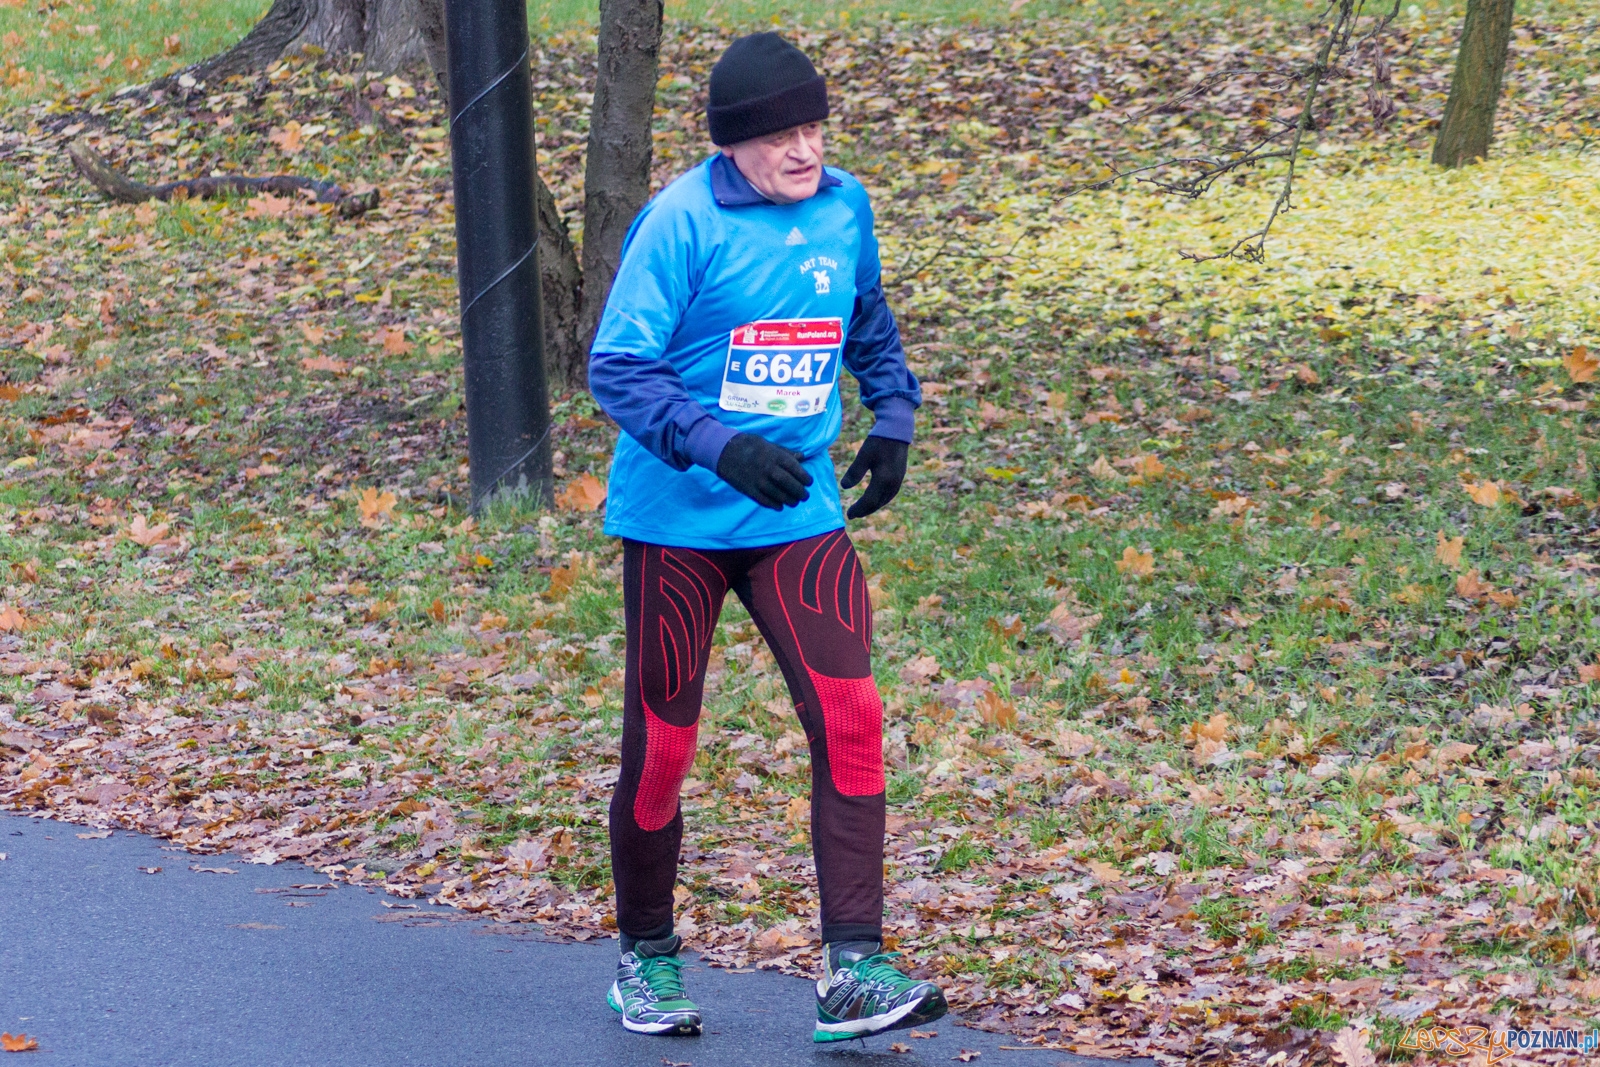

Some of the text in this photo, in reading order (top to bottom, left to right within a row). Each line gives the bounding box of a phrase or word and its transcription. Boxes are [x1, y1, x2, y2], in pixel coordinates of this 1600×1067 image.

[799, 256, 838, 275] ART TEAM
[796, 330, 837, 339] RunPoland.org
[730, 352, 831, 384] E 6647
[776, 389, 801, 397] Marek
